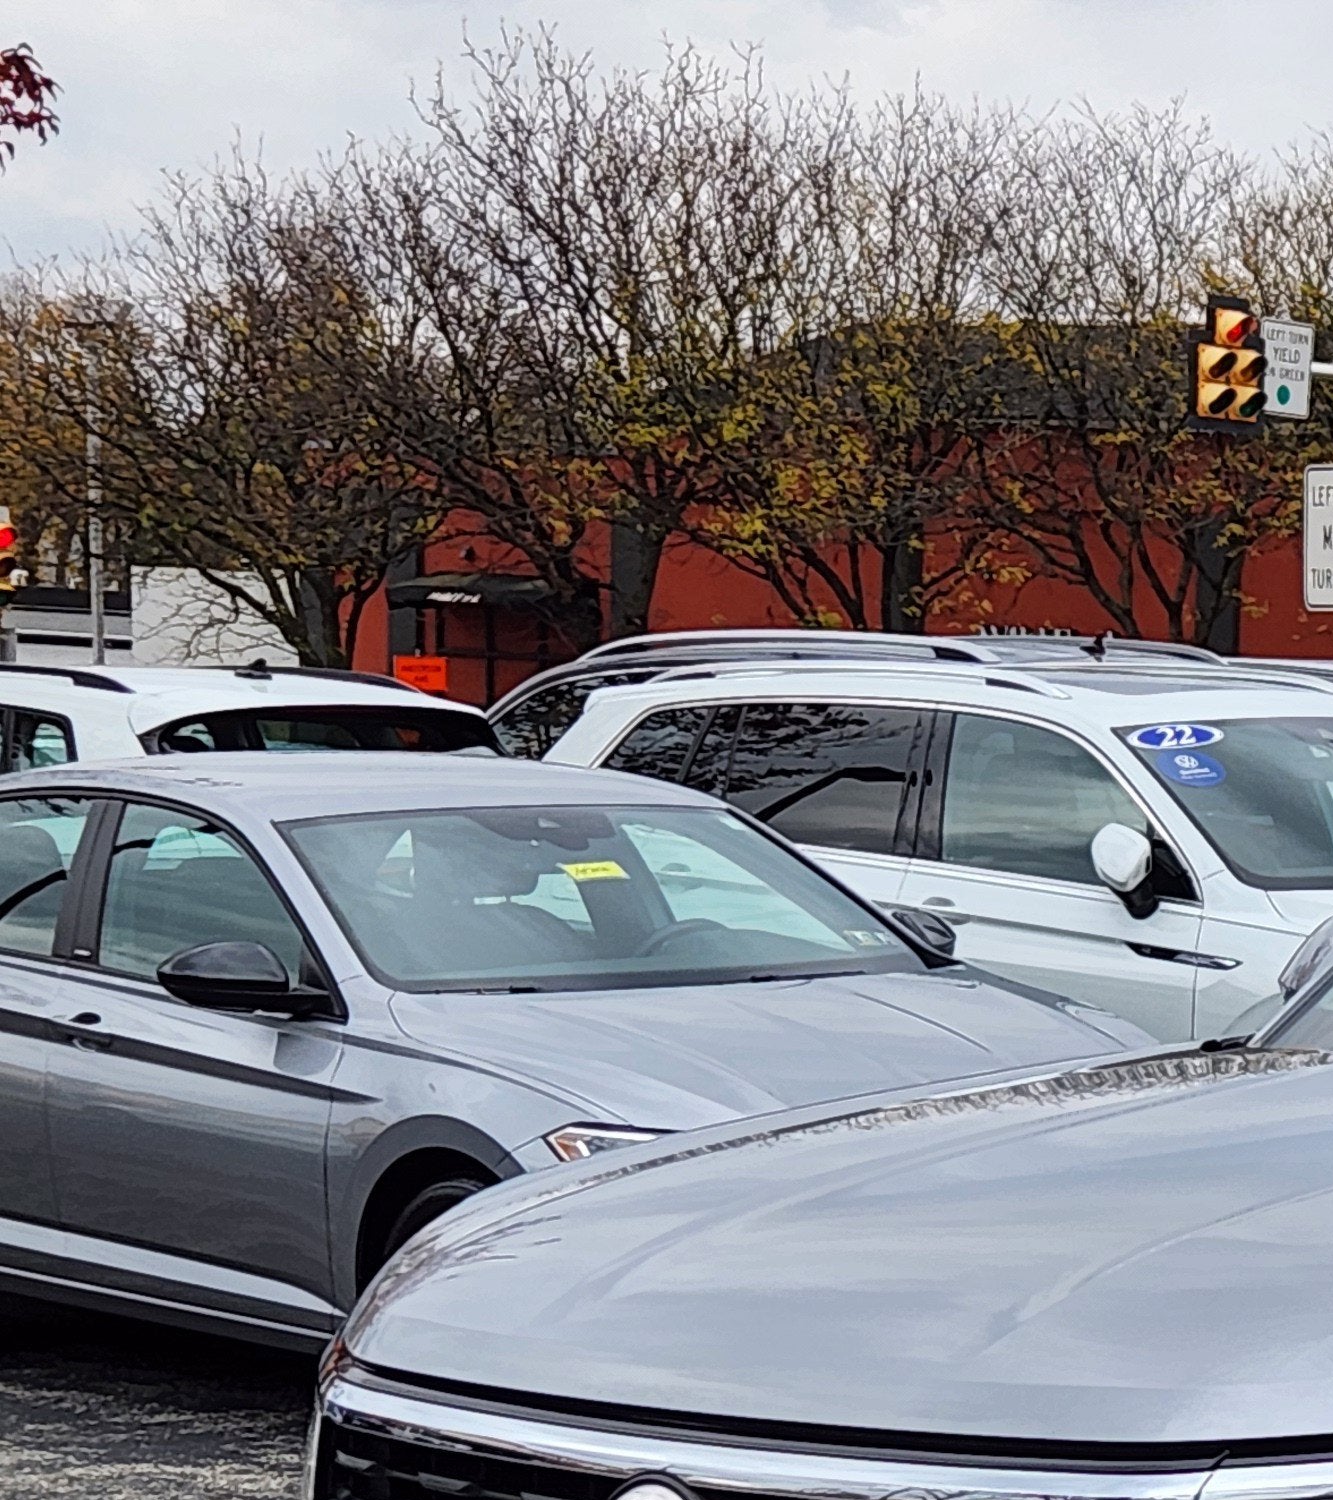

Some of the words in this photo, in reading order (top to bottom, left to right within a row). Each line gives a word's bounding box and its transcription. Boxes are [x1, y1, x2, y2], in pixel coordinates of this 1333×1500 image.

[1266, 328, 1286, 341] LEFT
[1288, 331, 1308, 345] TURN
[1273, 347, 1301, 364] YIELD
[1279, 368, 1305, 381] GREEN
[1155, 725, 1197, 747] 22
